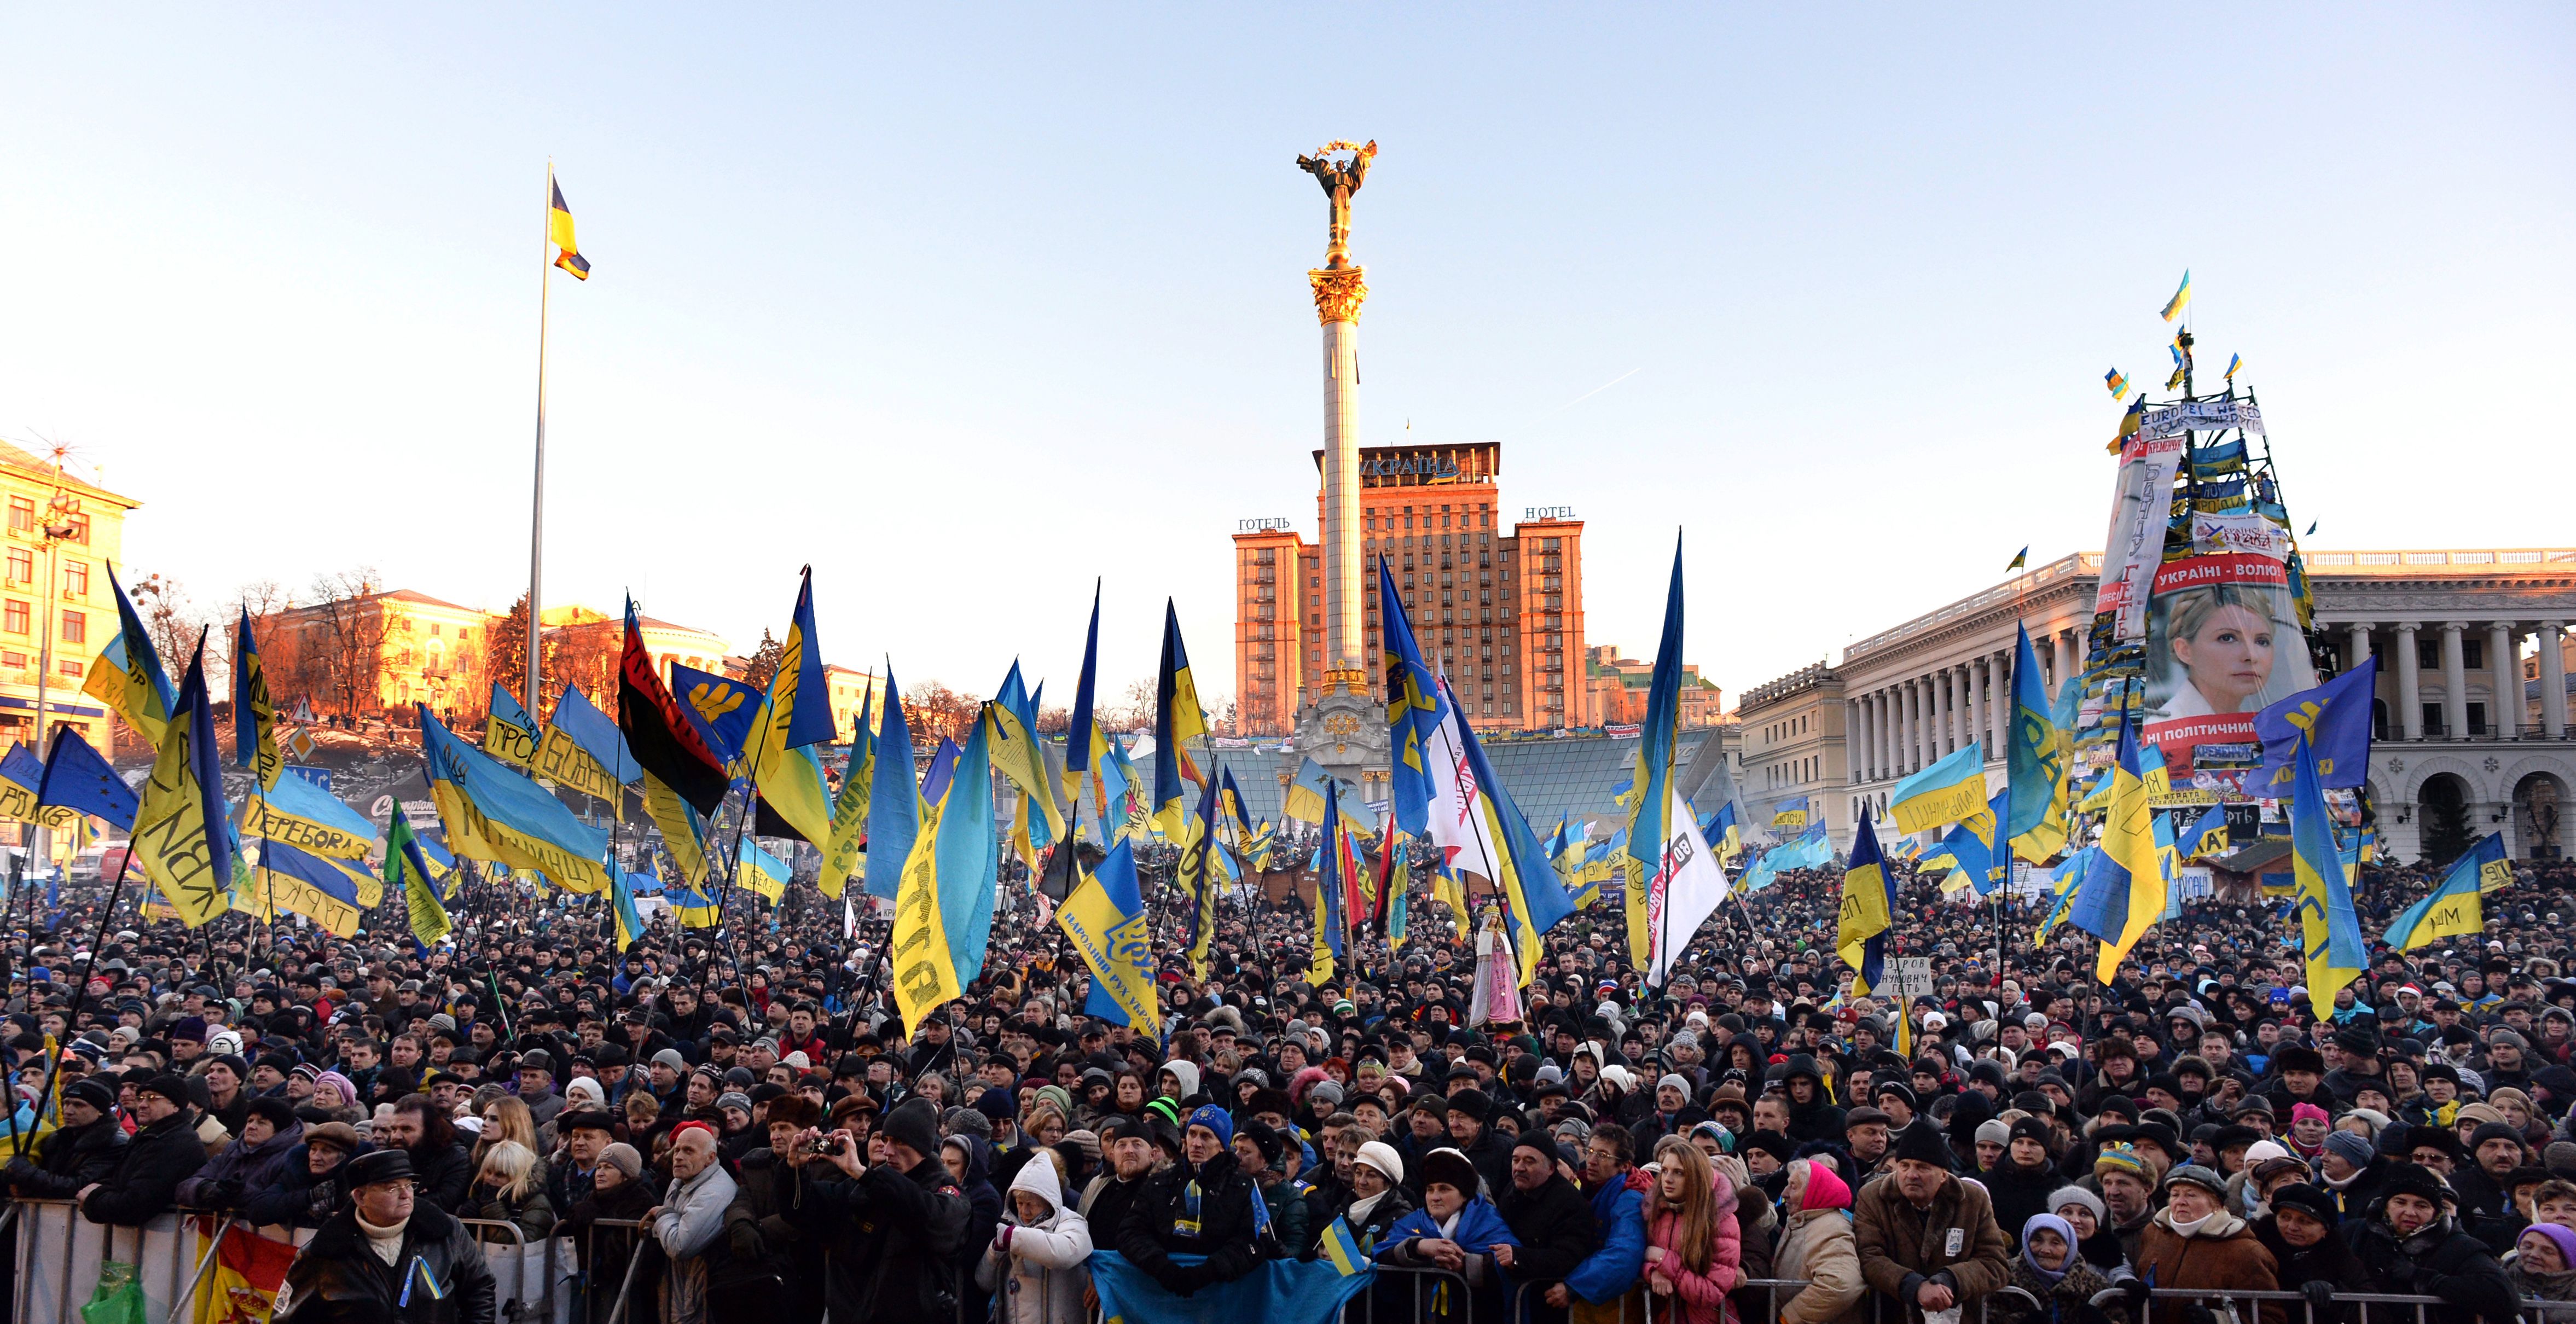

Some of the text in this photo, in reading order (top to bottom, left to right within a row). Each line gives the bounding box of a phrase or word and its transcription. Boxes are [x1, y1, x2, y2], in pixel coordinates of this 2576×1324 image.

[1525, 506, 1576, 519] HOTEL
[1238, 518, 1290, 530] ГОТЕЛЬ
[2159, 565, 2221, 586] УКРАЇНІ
[2235, 564, 2282, 577] ВОЛЮ!
[2146, 734, 2161, 744] НІ
[1109, 973, 1129, 998] РУХ
